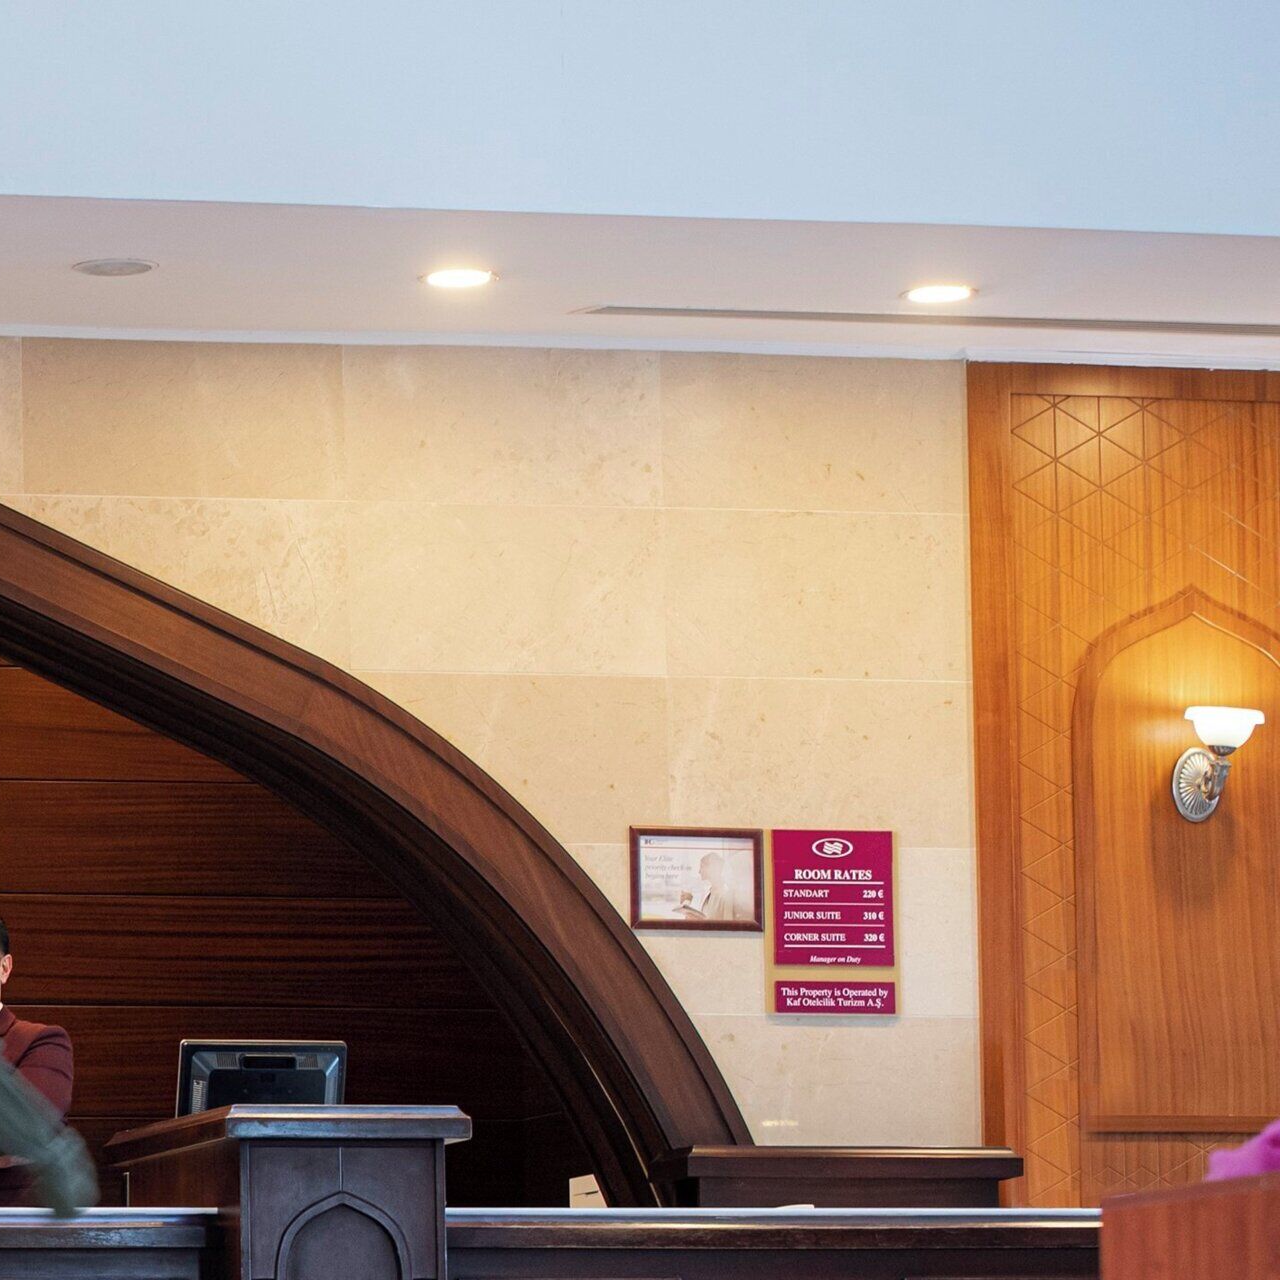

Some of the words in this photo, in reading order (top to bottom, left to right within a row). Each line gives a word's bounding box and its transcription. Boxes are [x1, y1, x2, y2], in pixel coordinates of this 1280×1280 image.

[794, 870, 831, 880] ROOM
[834, 870, 872, 880] RATES
[783, 890, 830, 898] STANDART
[862, 890, 876, 898] 220
[878, 890, 884, 898] €
[784, 911, 814, 920] JUNIOR
[816, 911, 841, 920] SUITE
[863, 912, 877, 920] 310
[878, 912, 884, 920] €
[784, 933, 820, 942] CORNER
[821, 933, 846, 942] SUITE
[864, 934, 878, 942] 320
[878, 934, 885, 942] €
[809, 956, 836, 964] Manager
[846, 956, 861, 964] Duty
[780, 987, 798, 996] This
[800, 987, 832, 998] Property
[834, 987, 841, 996] is
[842, 987, 877, 998] Operated
[878, 987, 888, 998] by
[786, 998, 800, 1006] Kaf
[802, 998, 836, 1006] Otelcilik
[837, 998, 865, 1007] Turizm
[866, 998, 884, 1009] A.Ş.
